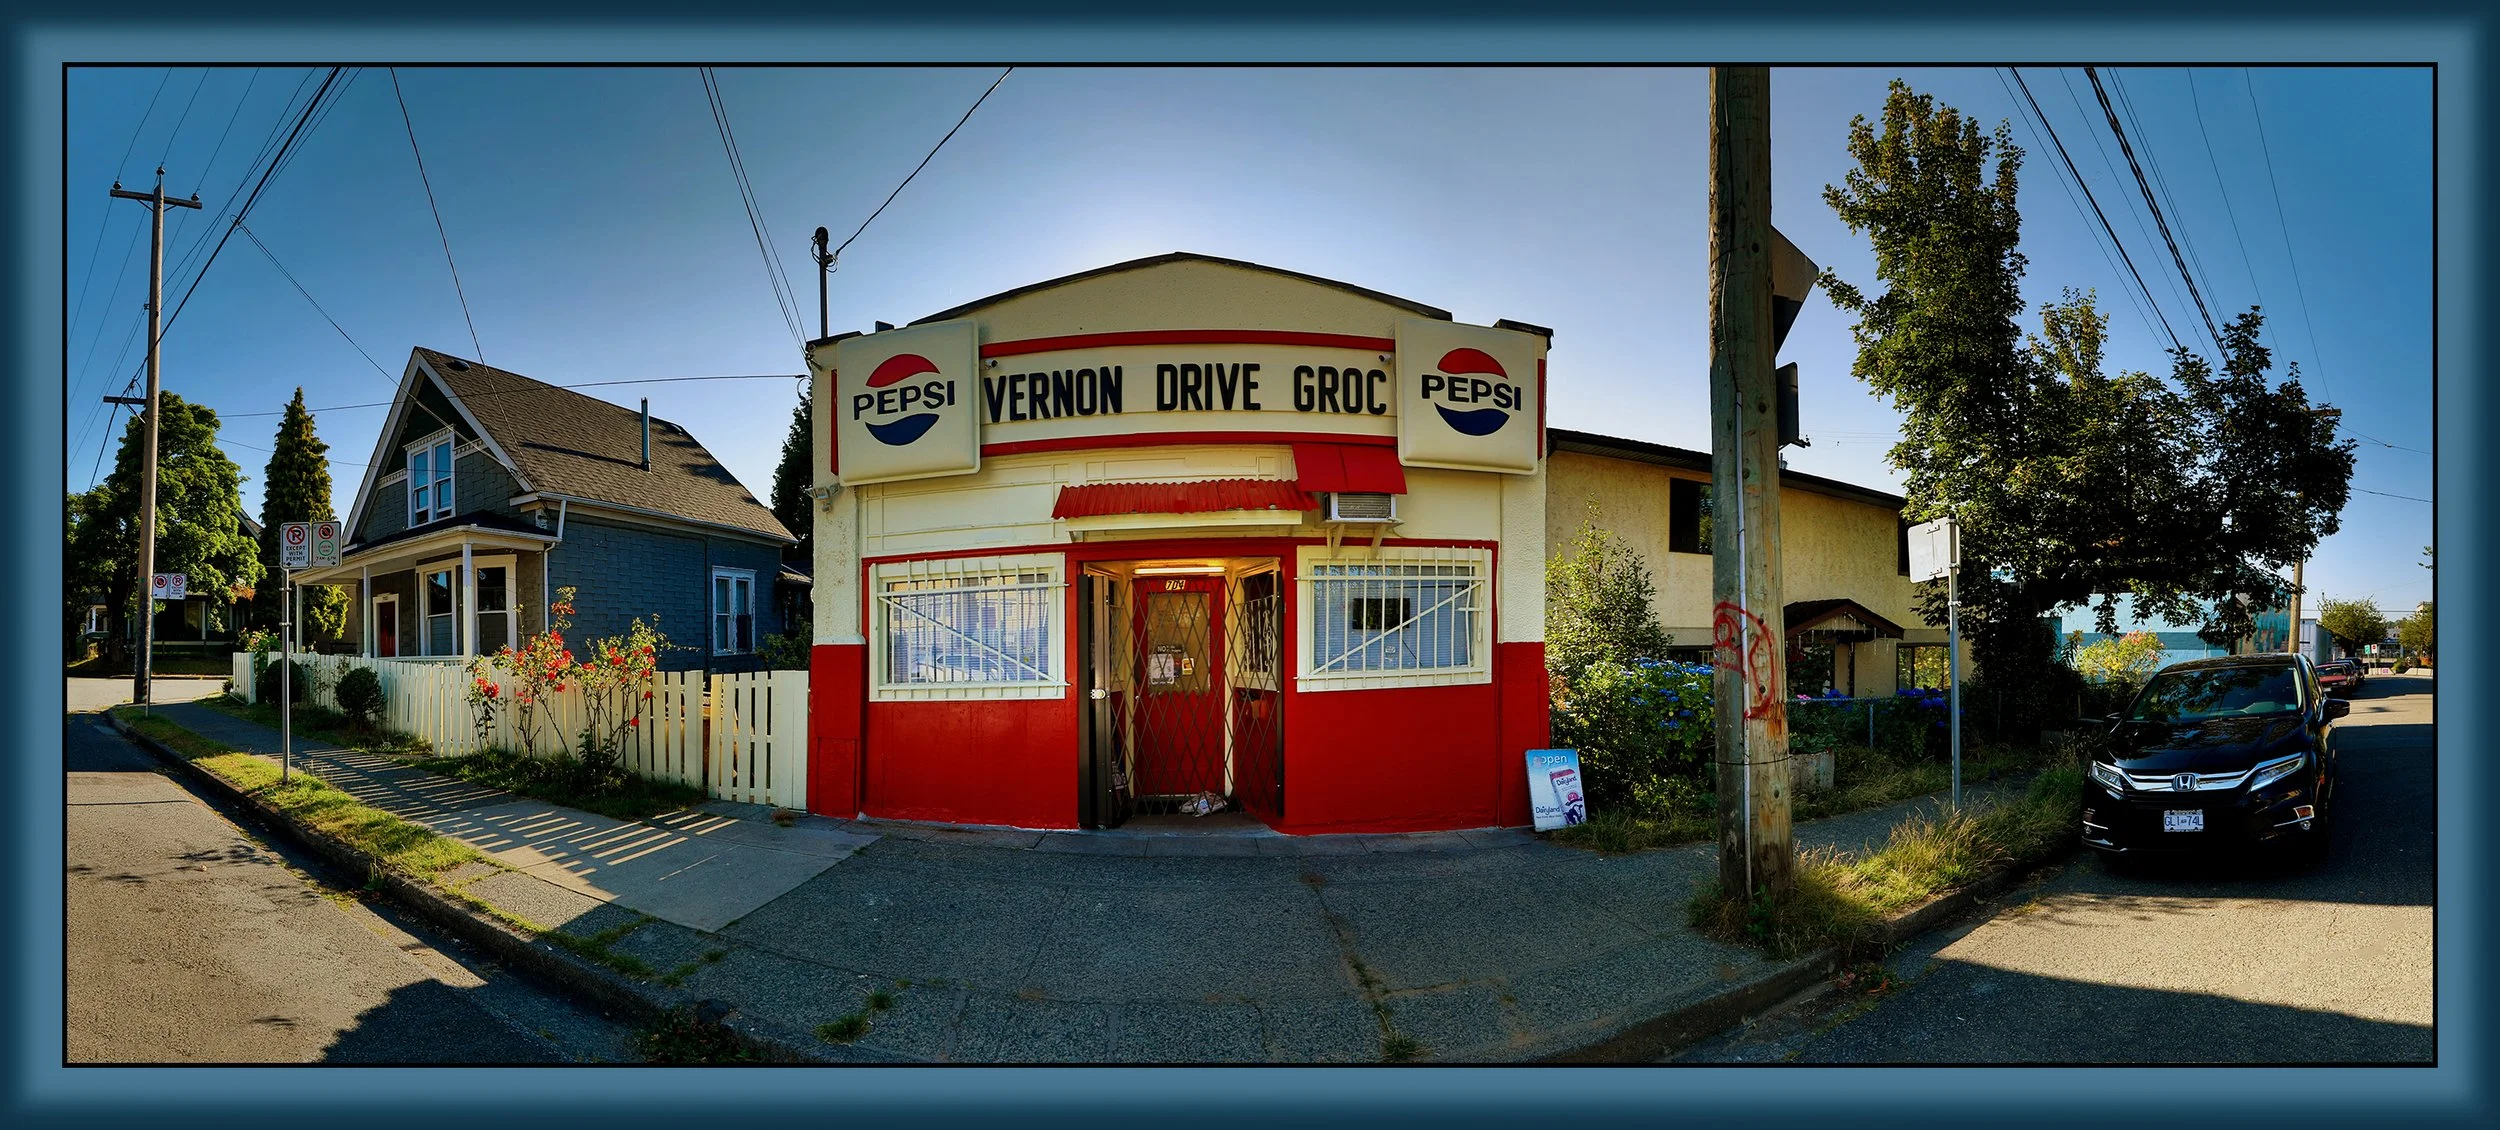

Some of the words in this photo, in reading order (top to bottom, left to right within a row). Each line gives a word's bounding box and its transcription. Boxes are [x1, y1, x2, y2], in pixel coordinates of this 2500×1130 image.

[853, 380, 955, 421] PEPSI
[984, 365, 1123, 423] VERNON
[1156, 363, 1261, 412] DRIVE
[1294, 365, 1387, 416] GROC
[1421, 374, 1521, 411] PEPSI
[1166, 580, 1185, 590] 704
[1556, 776, 1577, 786] Dairyland
[1535, 806, 1560, 815] Dairyland
